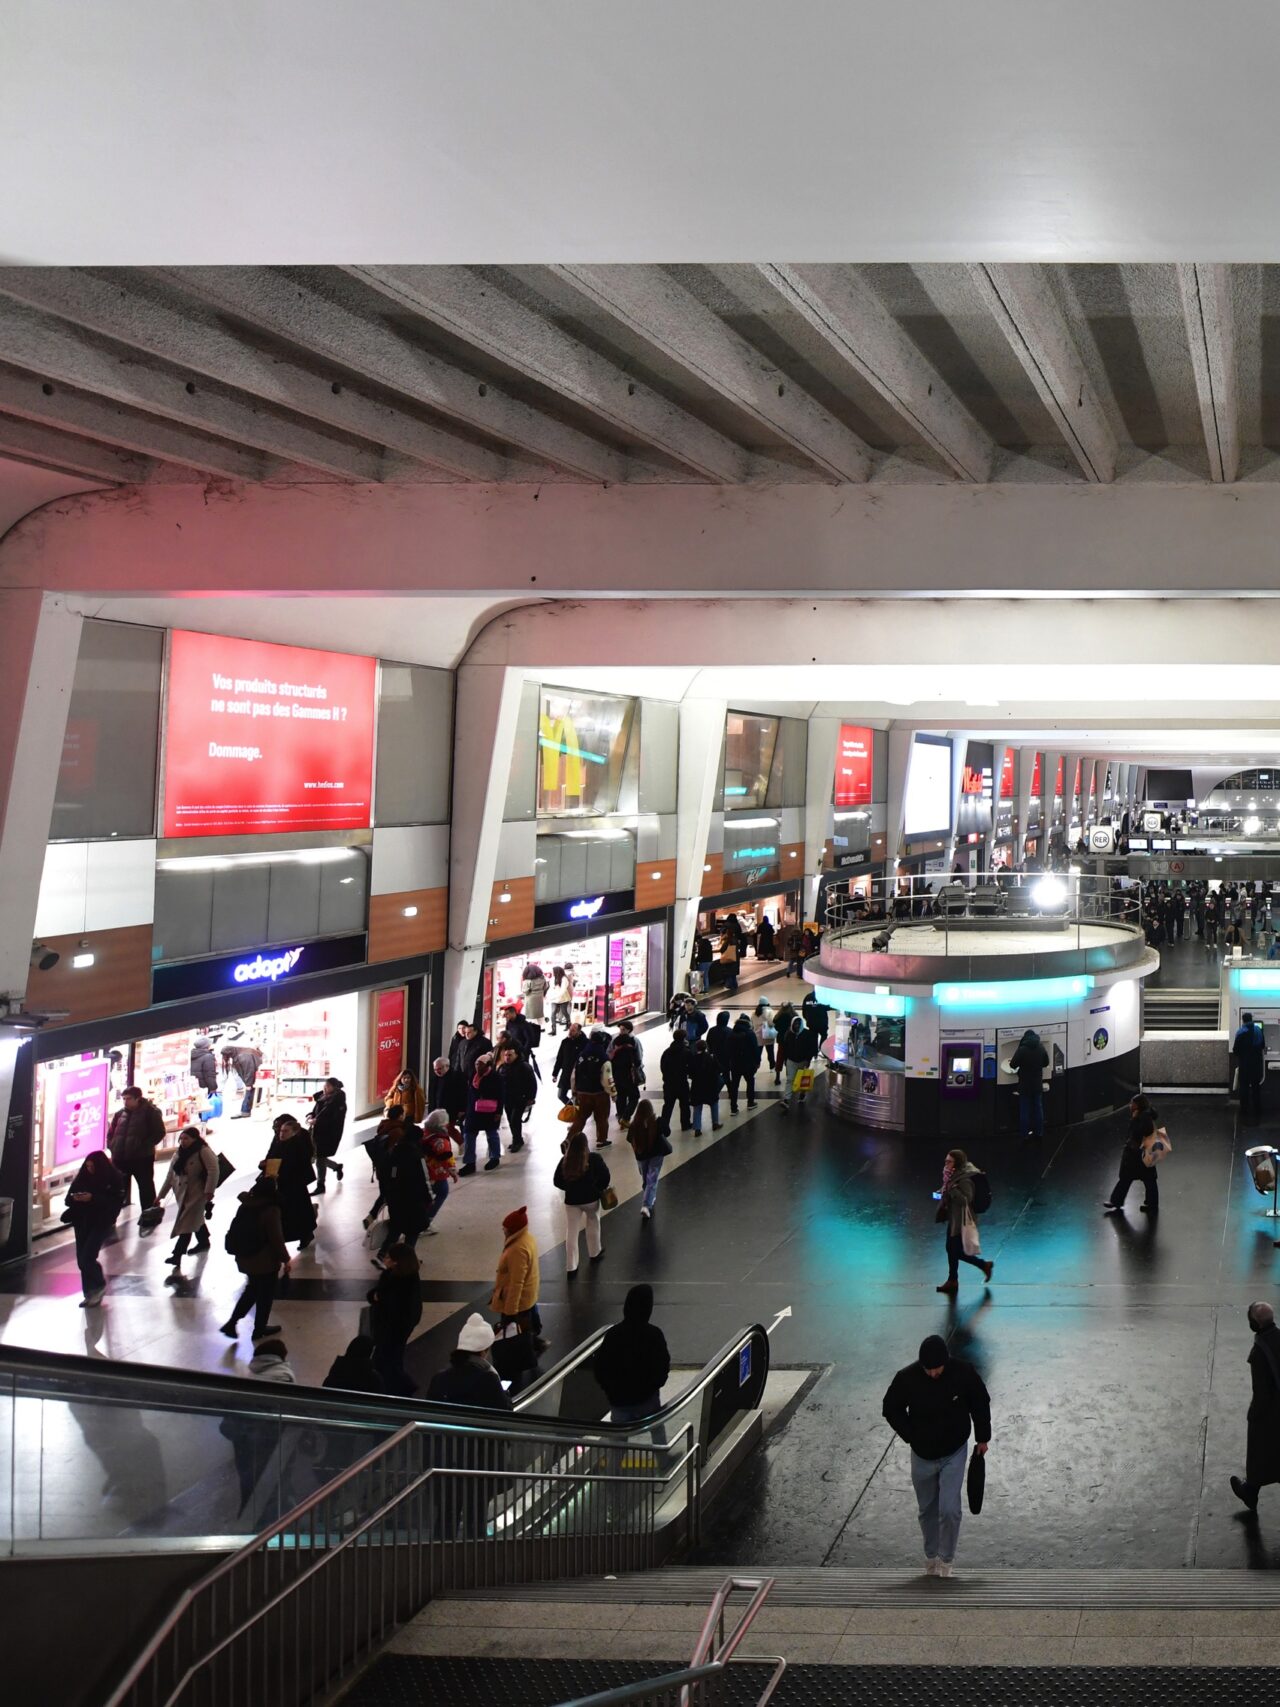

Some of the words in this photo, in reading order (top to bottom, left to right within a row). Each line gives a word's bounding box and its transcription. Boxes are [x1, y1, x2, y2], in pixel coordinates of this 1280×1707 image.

[212, 673, 232, 690] Vos
[235, 677, 278, 695] produits
[279, 681, 327, 699] structurés
[211, 698, 225, 712] ne
[226, 699, 251, 714] sont
[253, 702, 272, 719] pas
[273, 702, 291, 718] des
[292, 703, 331, 720] Gammes
[332, 706, 340, 720] H
[341, 708, 347, 721] ?
[208, 742, 263, 761] Dommage.
[1094, 835, 1108, 843] RER
[379, 1038, 400, 1051] 50%
